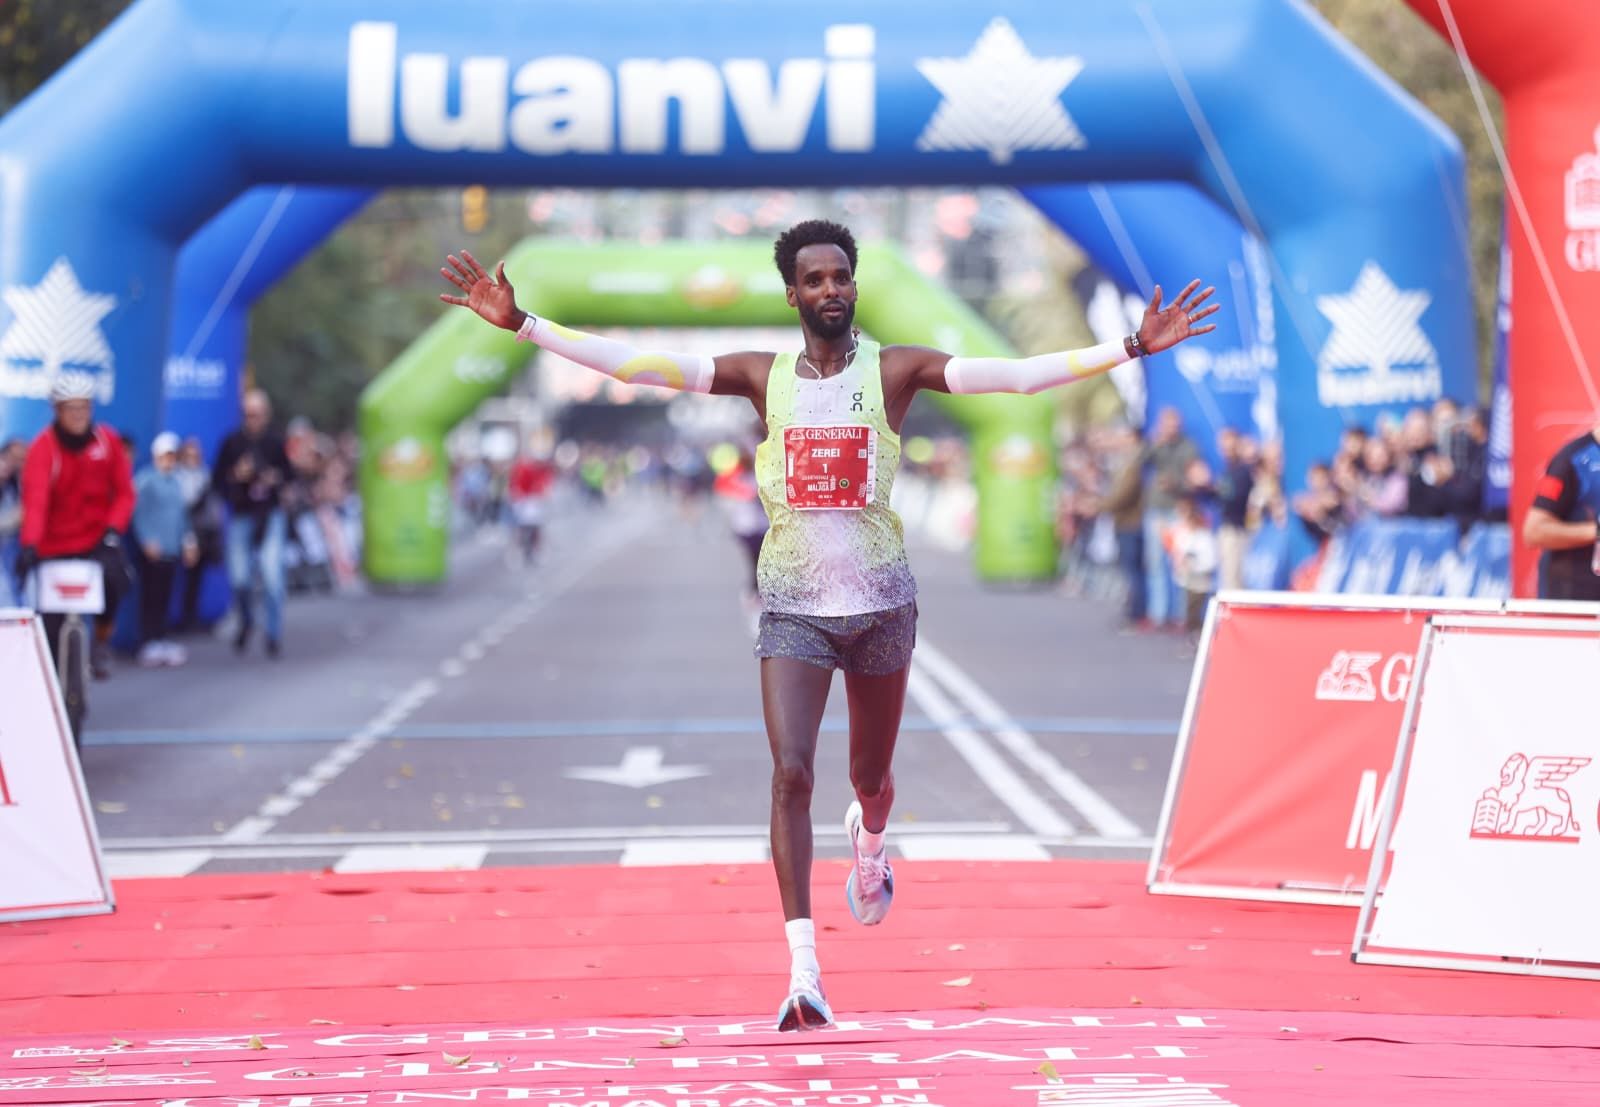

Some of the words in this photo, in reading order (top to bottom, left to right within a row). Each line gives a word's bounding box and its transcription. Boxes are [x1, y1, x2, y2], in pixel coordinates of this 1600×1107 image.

[347, 22, 876, 155] luanvi
[805, 428, 862, 440] GENERALI
[811, 448, 840, 458] ZEREI
[821, 463, 828, 474] 1
[1380, 652, 1412, 702] G
[314, 1014, 1226, 1046] GENERALI
[243, 1044, 1208, 1081] GENERALI
